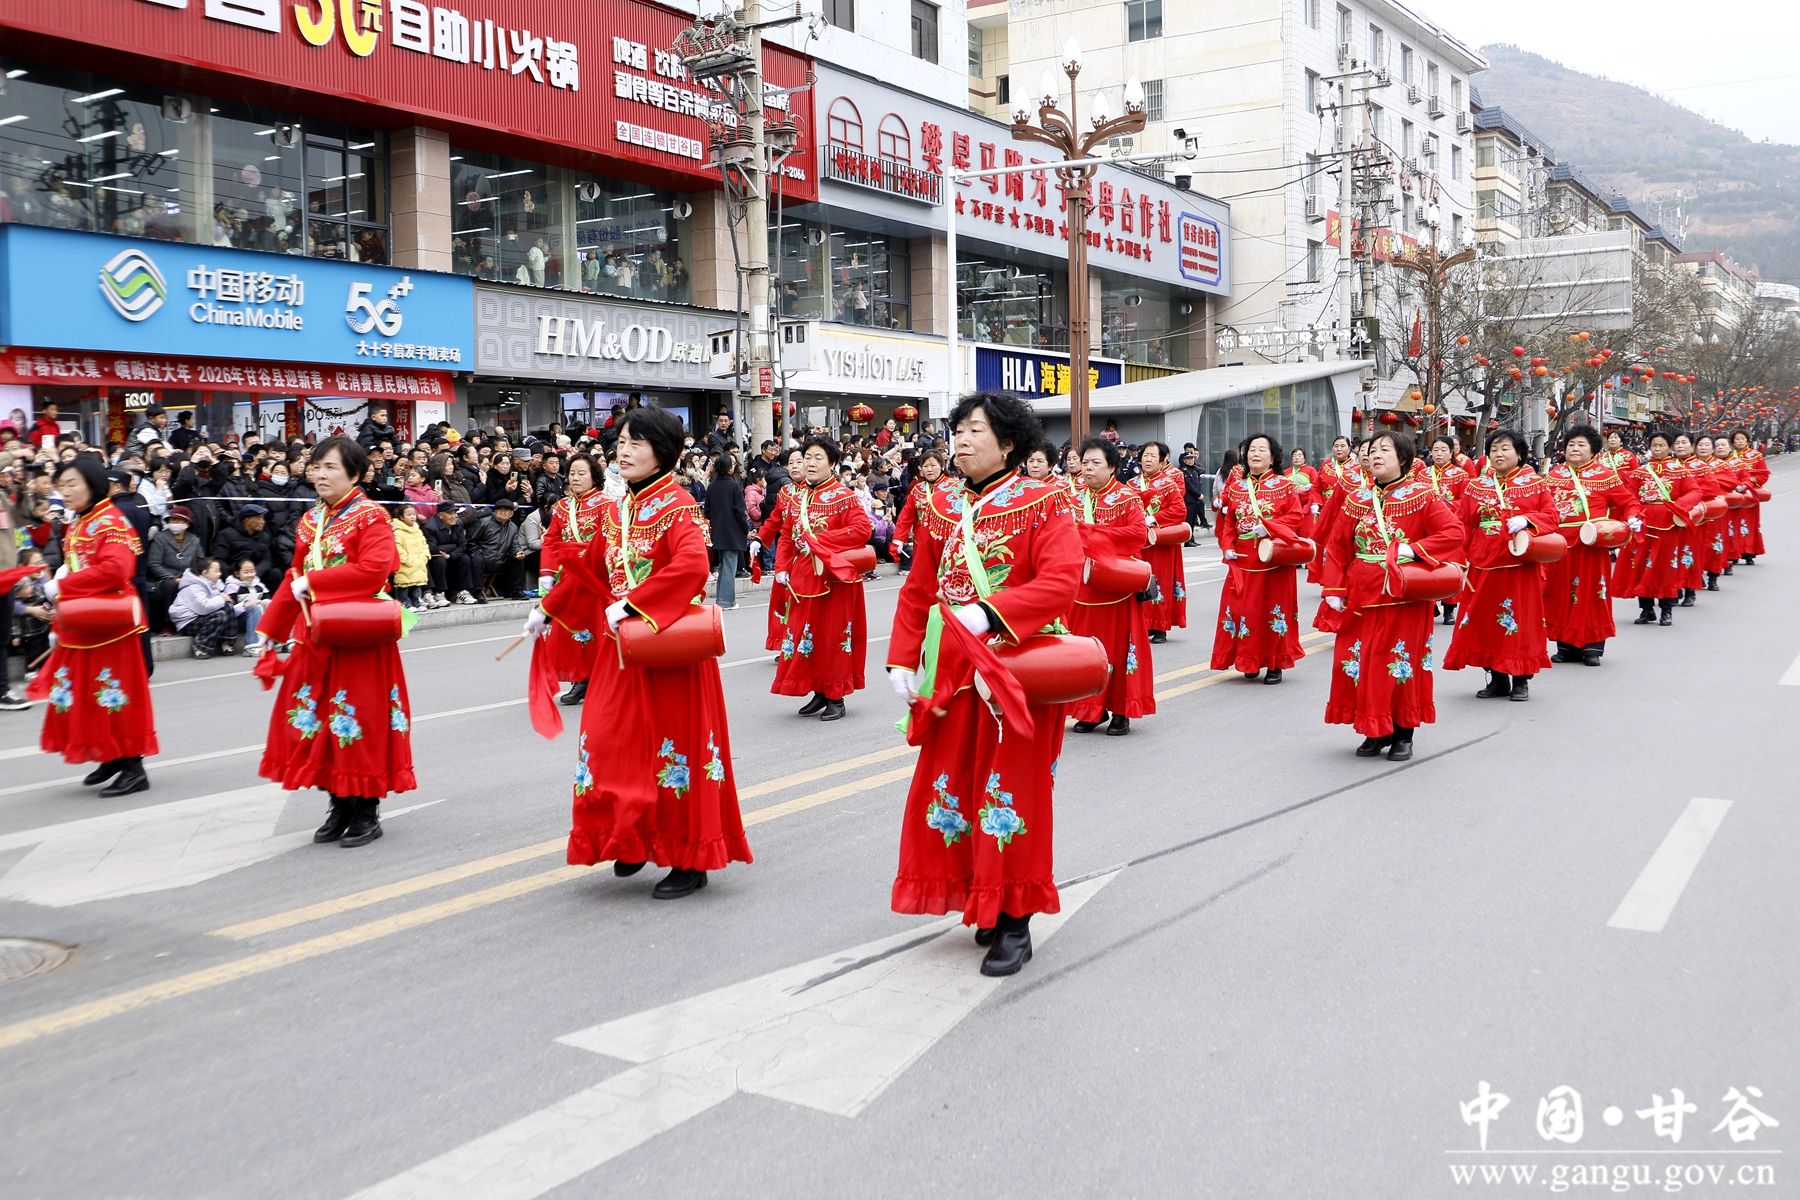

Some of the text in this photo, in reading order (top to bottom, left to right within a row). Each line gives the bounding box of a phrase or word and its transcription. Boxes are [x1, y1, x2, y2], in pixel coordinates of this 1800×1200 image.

[614, 37, 648, 71] 啤酒
[618, 123, 701, 157] 全国连锁甘谷店
[187, 265, 304, 306] 中国移动
[355, 340, 462, 363] 大十字信发手机卖场
[534, 315, 673, 363] HM&OD
[1002, 357, 1099, 393] HLA 海澜家
